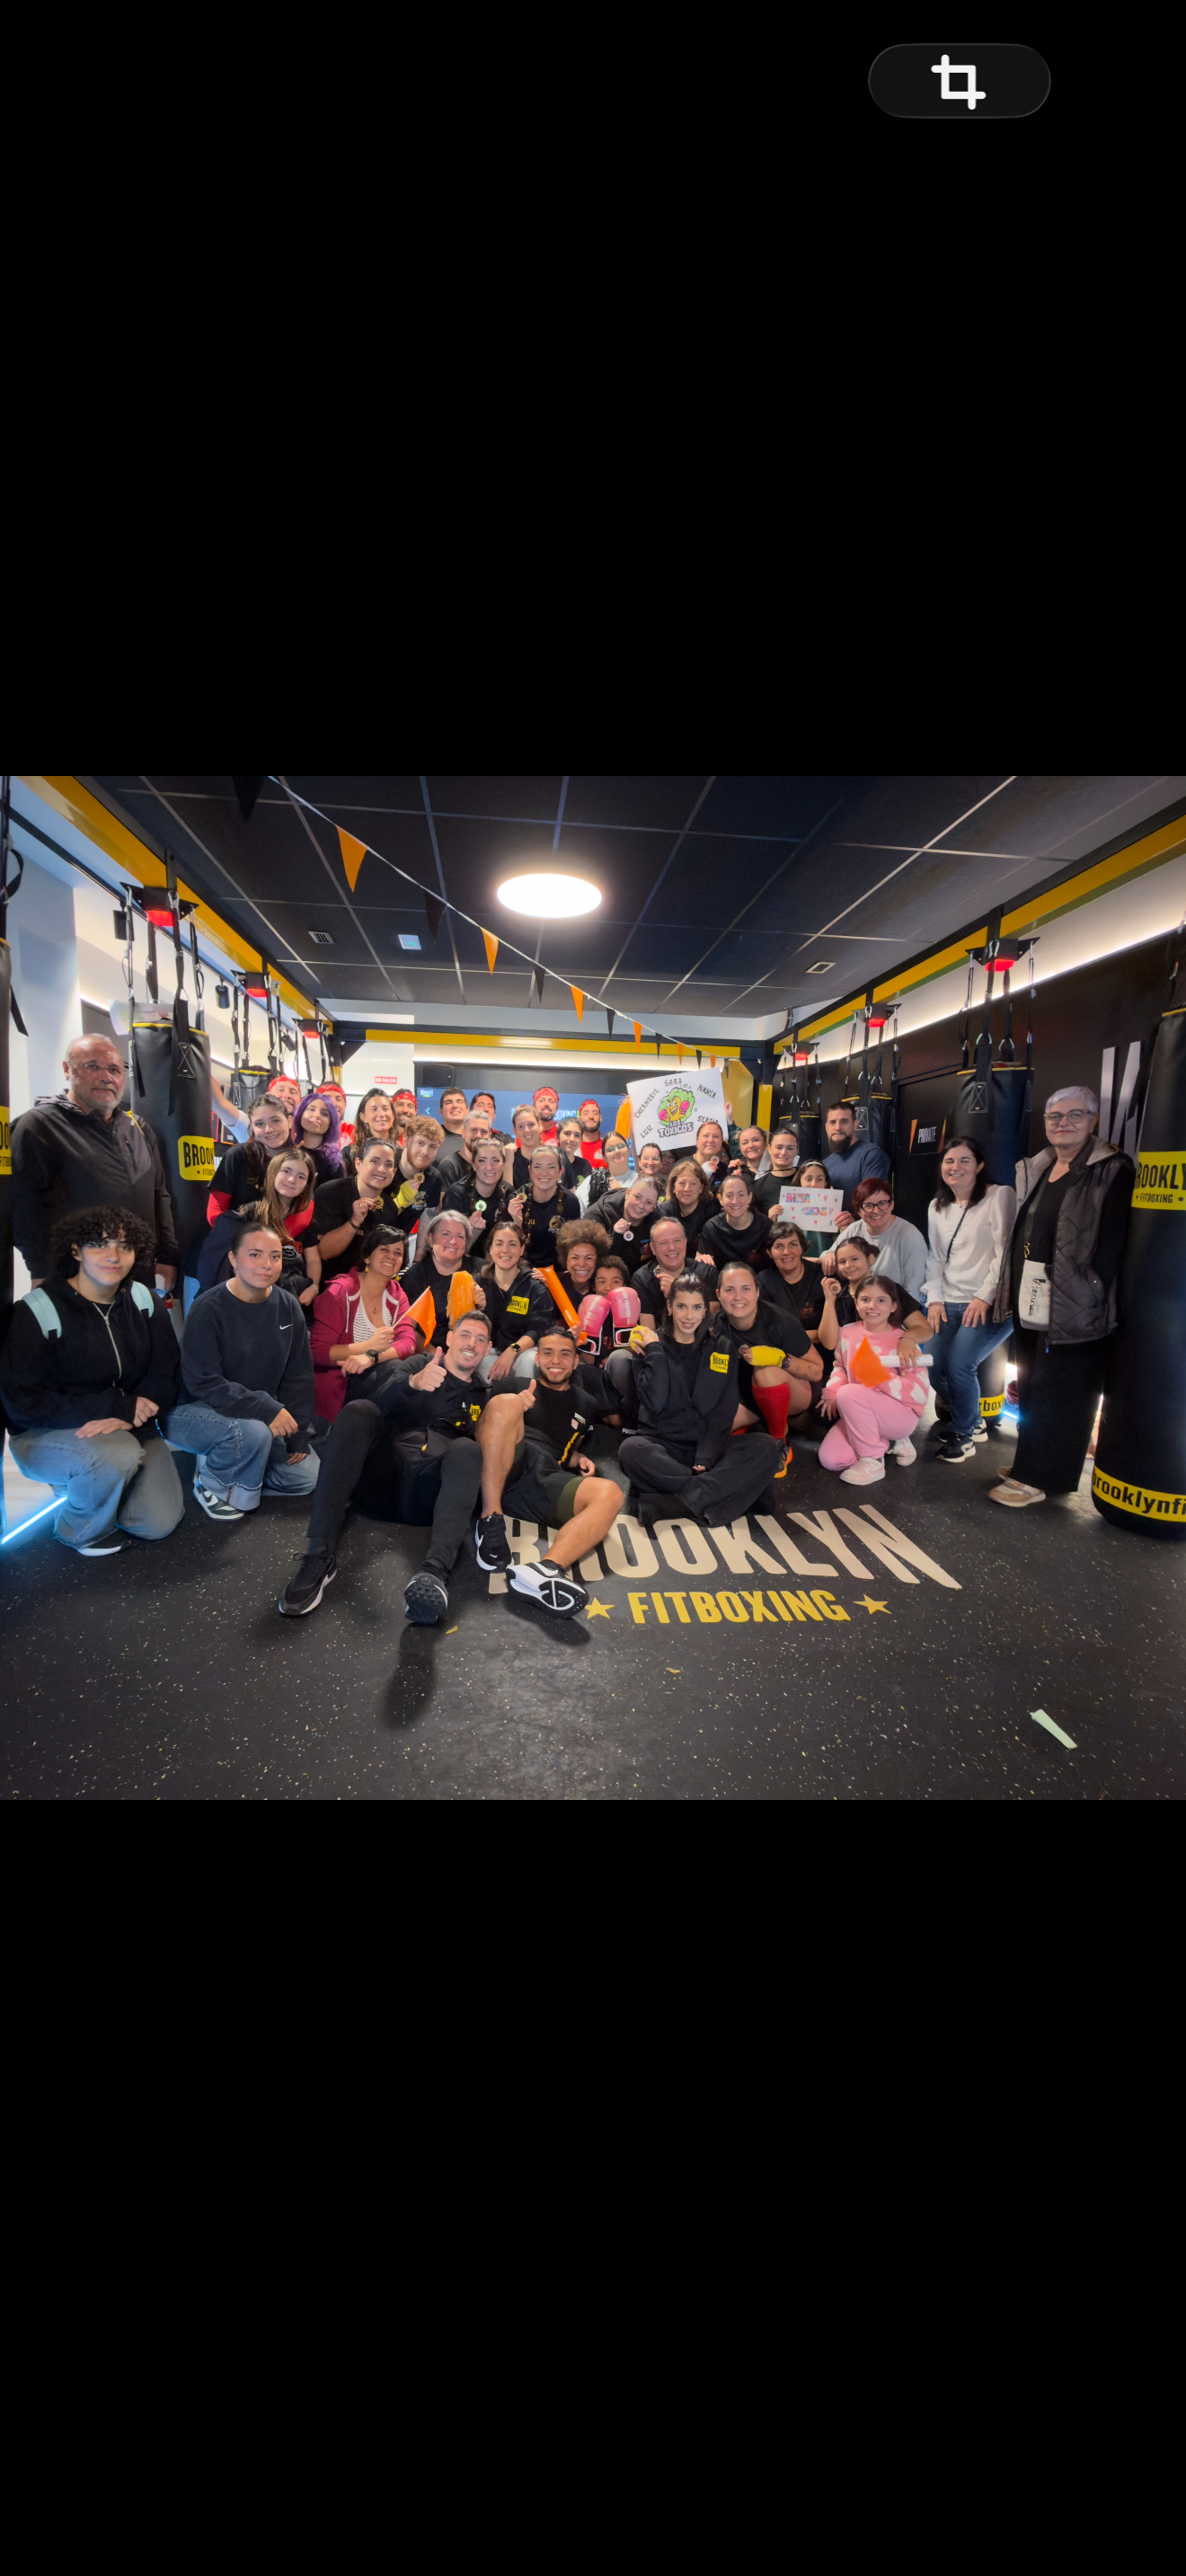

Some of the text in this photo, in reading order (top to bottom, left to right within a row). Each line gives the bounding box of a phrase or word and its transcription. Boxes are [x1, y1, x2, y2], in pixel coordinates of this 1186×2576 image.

[665, 1078, 682, 1087] SARA
[634, 1088, 659, 1119] CHERNOBYL
[640, 1125, 653, 1139] LUU
[917, 1126, 937, 1143] PRIVATE
[1140, 1193, 1173, 1204] FITBOXING
[627, 1589, 852, 1624] FITBOXING
